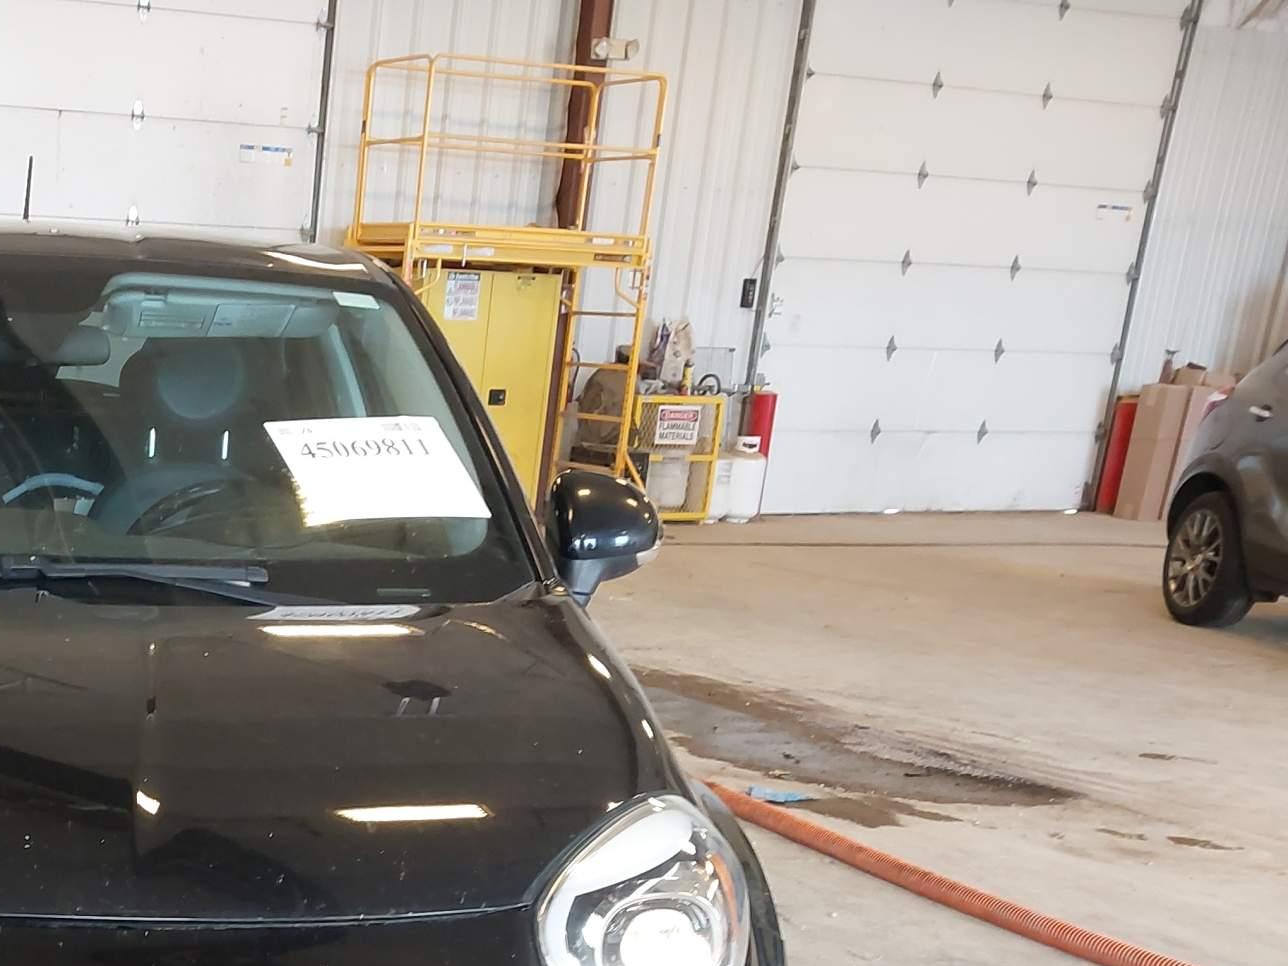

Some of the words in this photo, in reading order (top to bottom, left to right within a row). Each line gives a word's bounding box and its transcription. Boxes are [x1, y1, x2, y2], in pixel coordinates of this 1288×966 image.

[659, 422, 696, 431] FLAMMABLE
[659, 431, 694, 440] MATERIALS
[301, 439, 430, 459] 45069811
